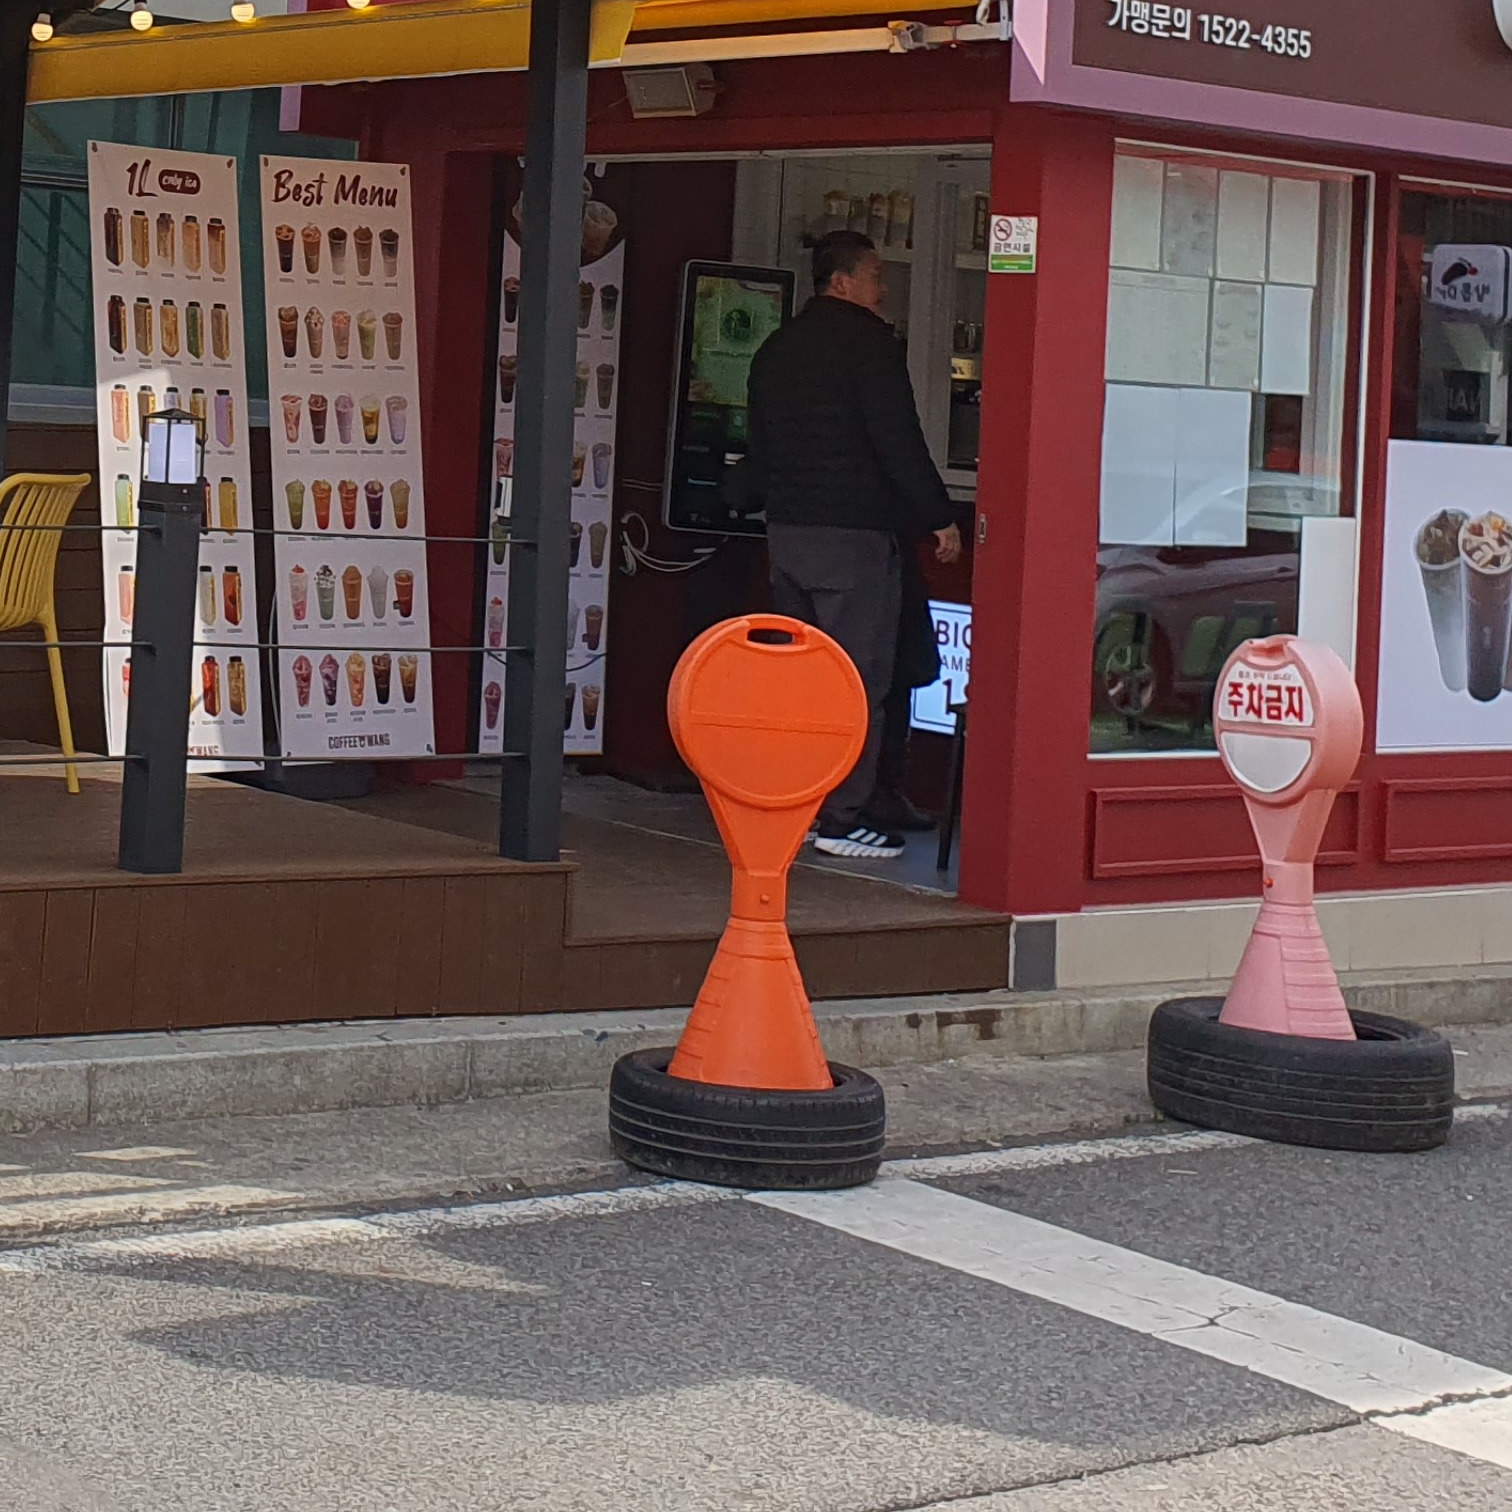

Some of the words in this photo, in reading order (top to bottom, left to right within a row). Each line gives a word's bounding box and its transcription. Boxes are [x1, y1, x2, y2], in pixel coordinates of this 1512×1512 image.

[1197, 14, 1312, 58] 1522-4355
[272, 169, 328, 207] Best
[333, 174, 398, 208] Menu
[1228, 681, 1304, 723] 주차금지
